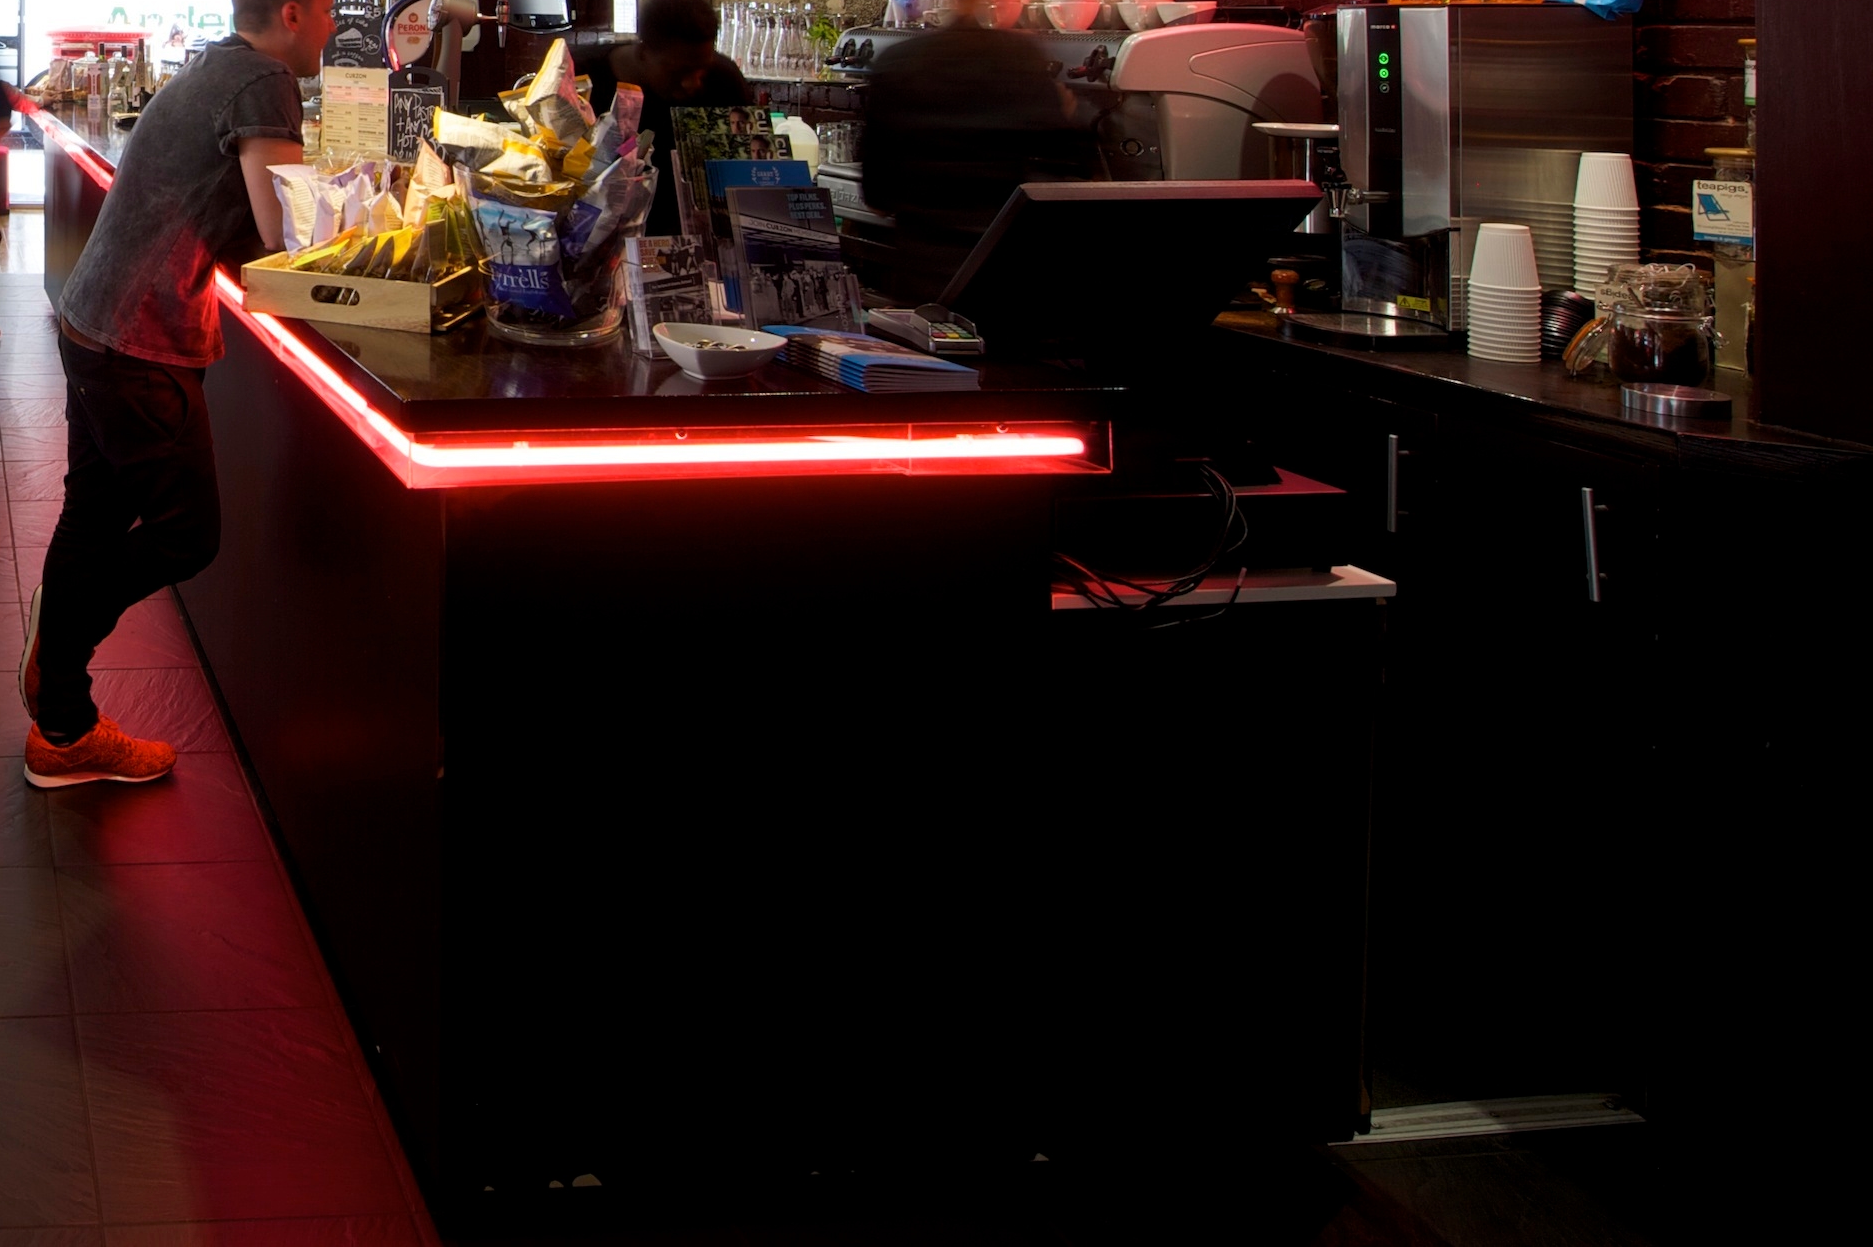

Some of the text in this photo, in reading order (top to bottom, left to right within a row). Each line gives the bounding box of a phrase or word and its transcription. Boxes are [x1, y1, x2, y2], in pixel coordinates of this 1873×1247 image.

[398, 23, 426, 32] PERON
[394, 93, 413, 117] ANY
[413, 93, 436, 123] PASTR
[397, 133, 417, 150] HOT
[766, 221, 793, 233] CURZON
